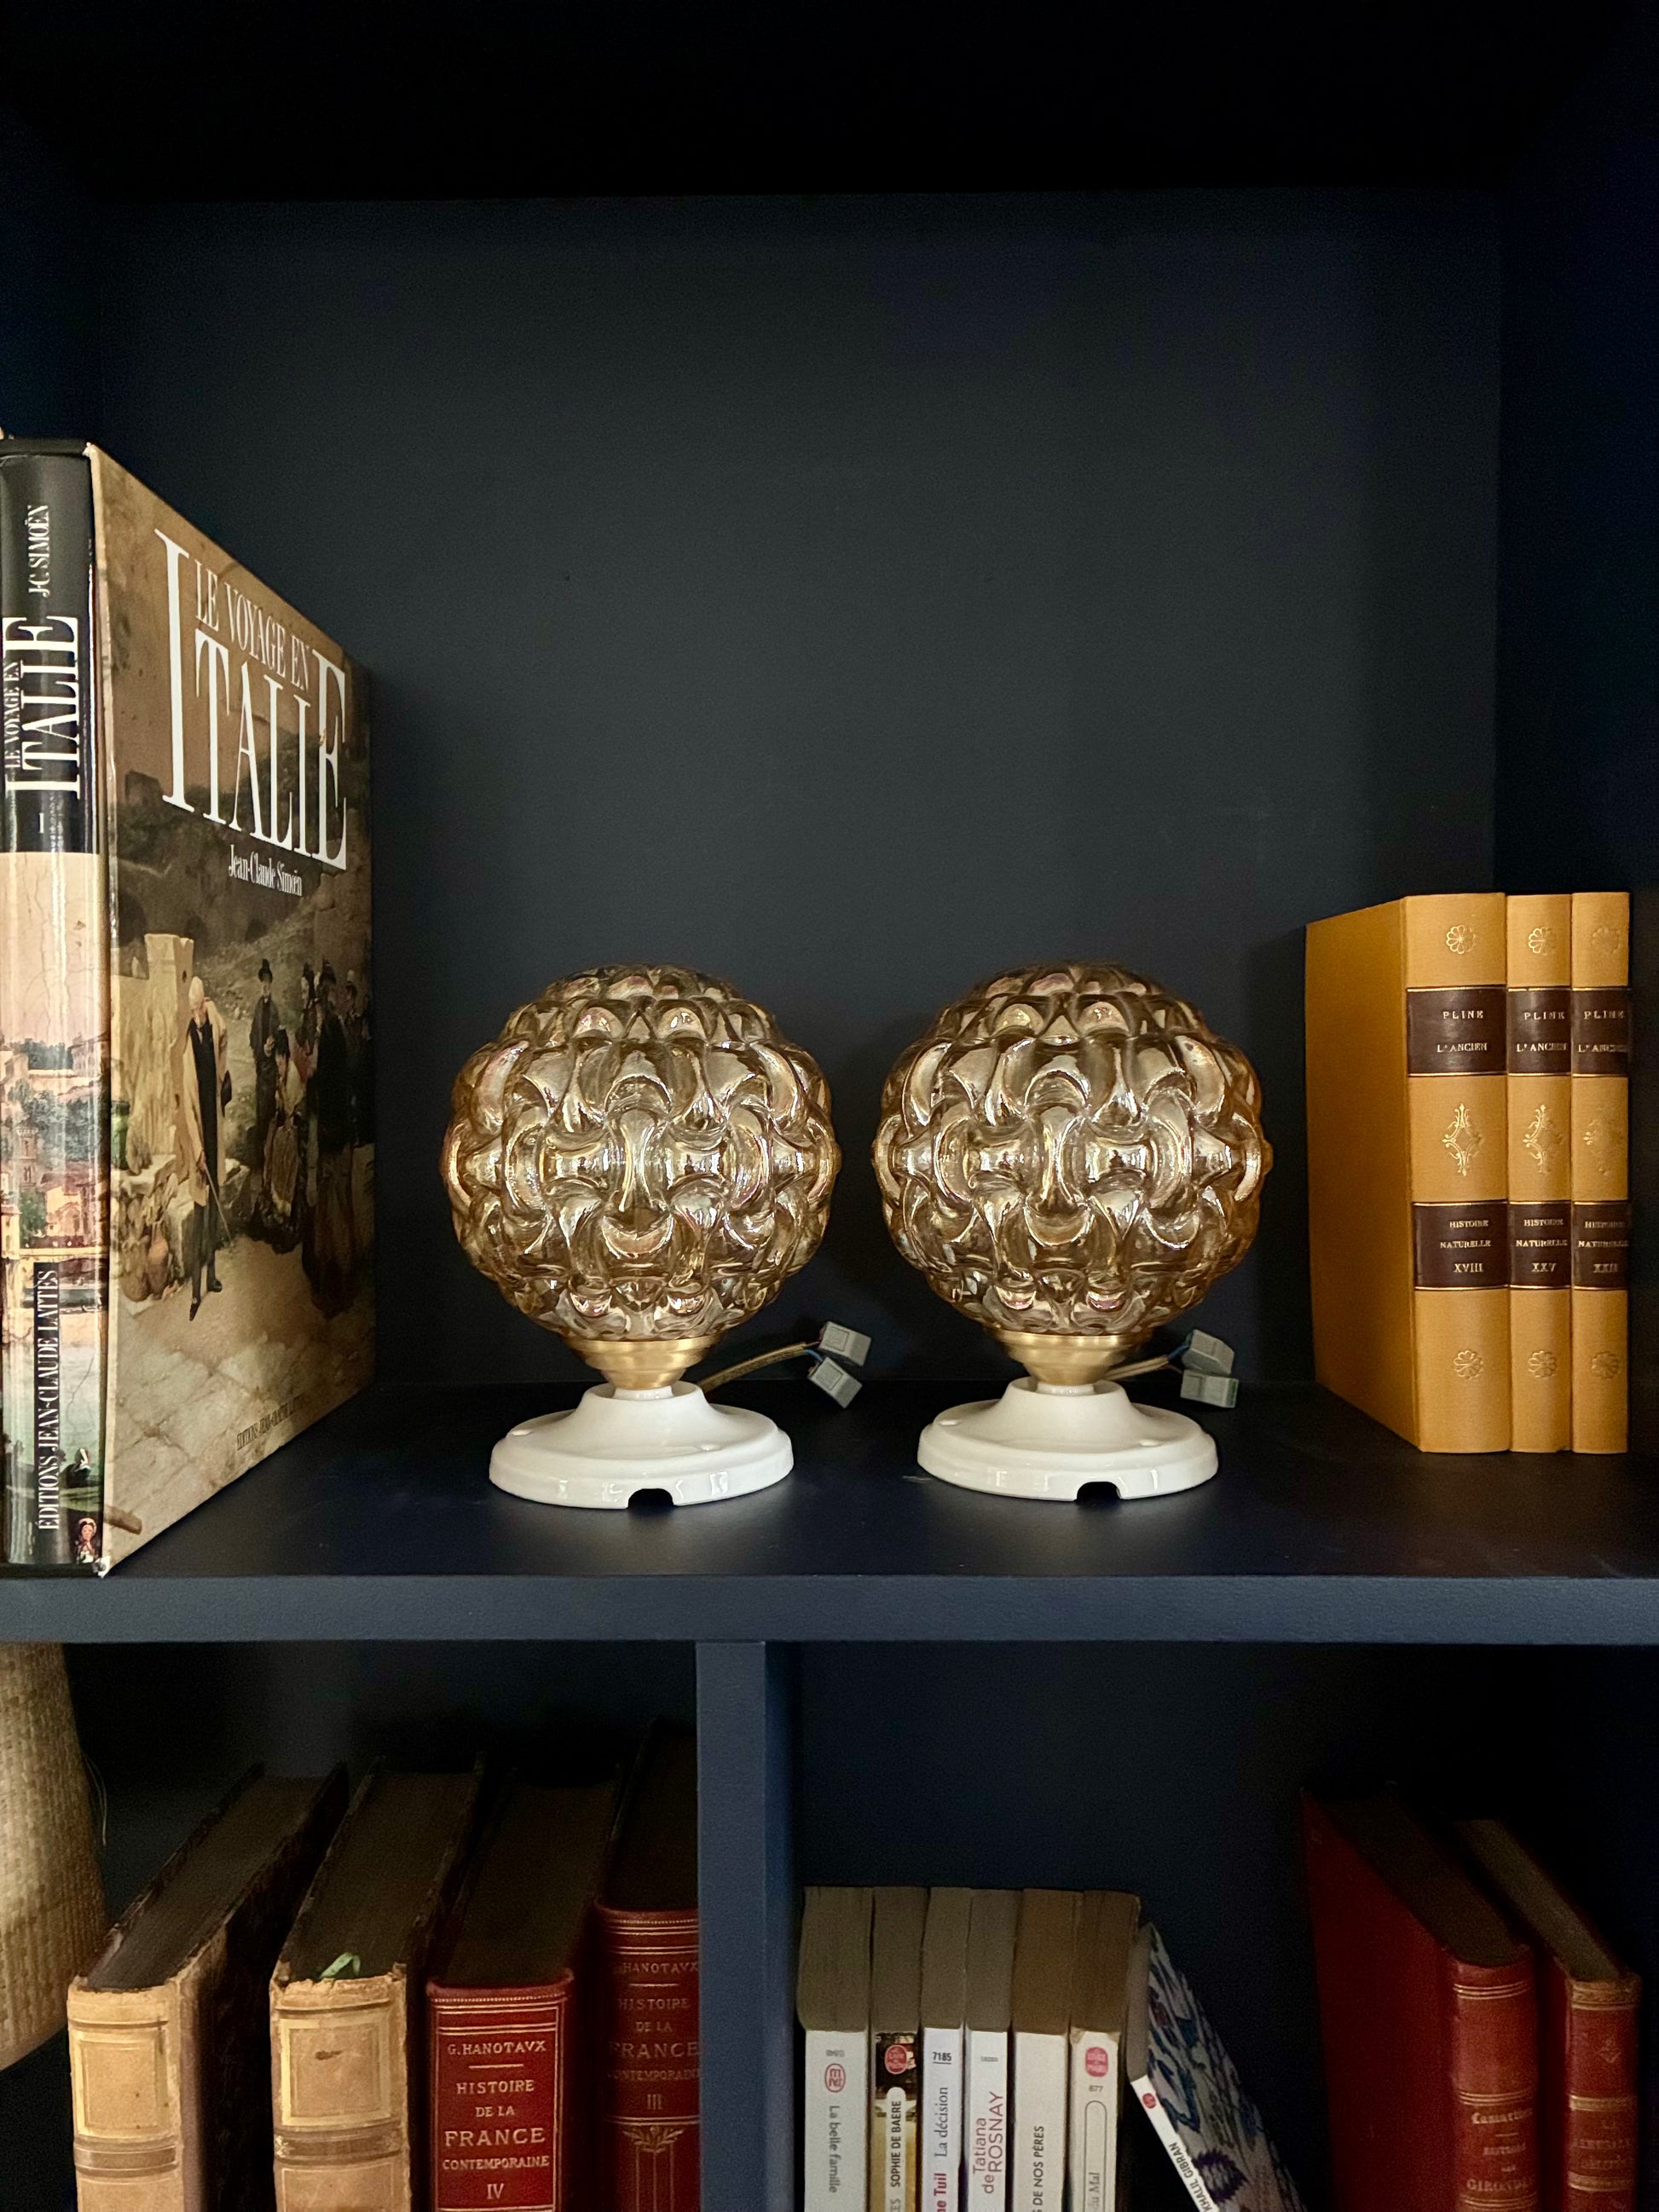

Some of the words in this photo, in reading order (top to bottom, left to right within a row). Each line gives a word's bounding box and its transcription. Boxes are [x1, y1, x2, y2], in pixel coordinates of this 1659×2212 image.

[194, 559, 219, 632] LE
[224, 581, 286, 679] VOYAGE
[291, 634, 309, 692] EN
[3, 661, 20, 682] EN
[2, 615, 80, 800] ITALIE
[154, 528, 345, 870] ITALIE
[3, 686, 20, 744] VOYAGE
[3, 749, 20, 768] LE
[228, 844, 275, 889] Jean-Claude
[1442, 1010, 1483, 1019] PLINE
[1449, 1220, 1489, 1228] HISTOIRE
[1440, 1240, 1491, 1249] NATURELLE
[1453, 1262, 1483, 1273] XVIII
[1531, 1262, 1557, 1273] XXV
[38, 1338, 59, 1452] JEAN-CLAUDE
[35, 1456, 59, 1529] ÉDITIONS
[618, 1998, 691, 2011] HISTOIRE
[635, 2021, 651, 2033] DE
[656, 2021, 673, 2032] LA
[932, 2052, 952, 2062] 7185
[456, 2080, 535, 2095] HISTOIRE
[475, 2106, 494, 2117] DE
[498, 2105, 516, 2117] LA
[646, 2094, 664, 2111] III
[829, 2105, 840, 2118] La
[934, 2087, 948, 2138] décision
[891, 2100, 901, 2129] BAERE
[444, 2128, 546, 2147] FRANCE
[829, 2122, 841, 2151] belle
[891, 2136, 900, 2149] DE
[973, 2118, 987, 2174] Tatiana
[982, 2174, 994, 2194] de
[988, 2092, 1003, 2173] ROSNAY
[934, 2142, 947, 2157] La
[442, 2156, 550, 2171] CONTEMPORAINE
[891, 2151, 900, 2187] SOPHIE
[1169, 2142, 1194, 2178] GIBRAN
[829, 2153, 841, 2193] famille
[1033, 2162, 1044, 2188] NOS
[1089, 2172, 1100, 2193] Mal
[487, 2184, 505, 2200] IV
[934, 2173, 946, 2194] Tuil
[1033, 2192, 1043, 2206] DE
